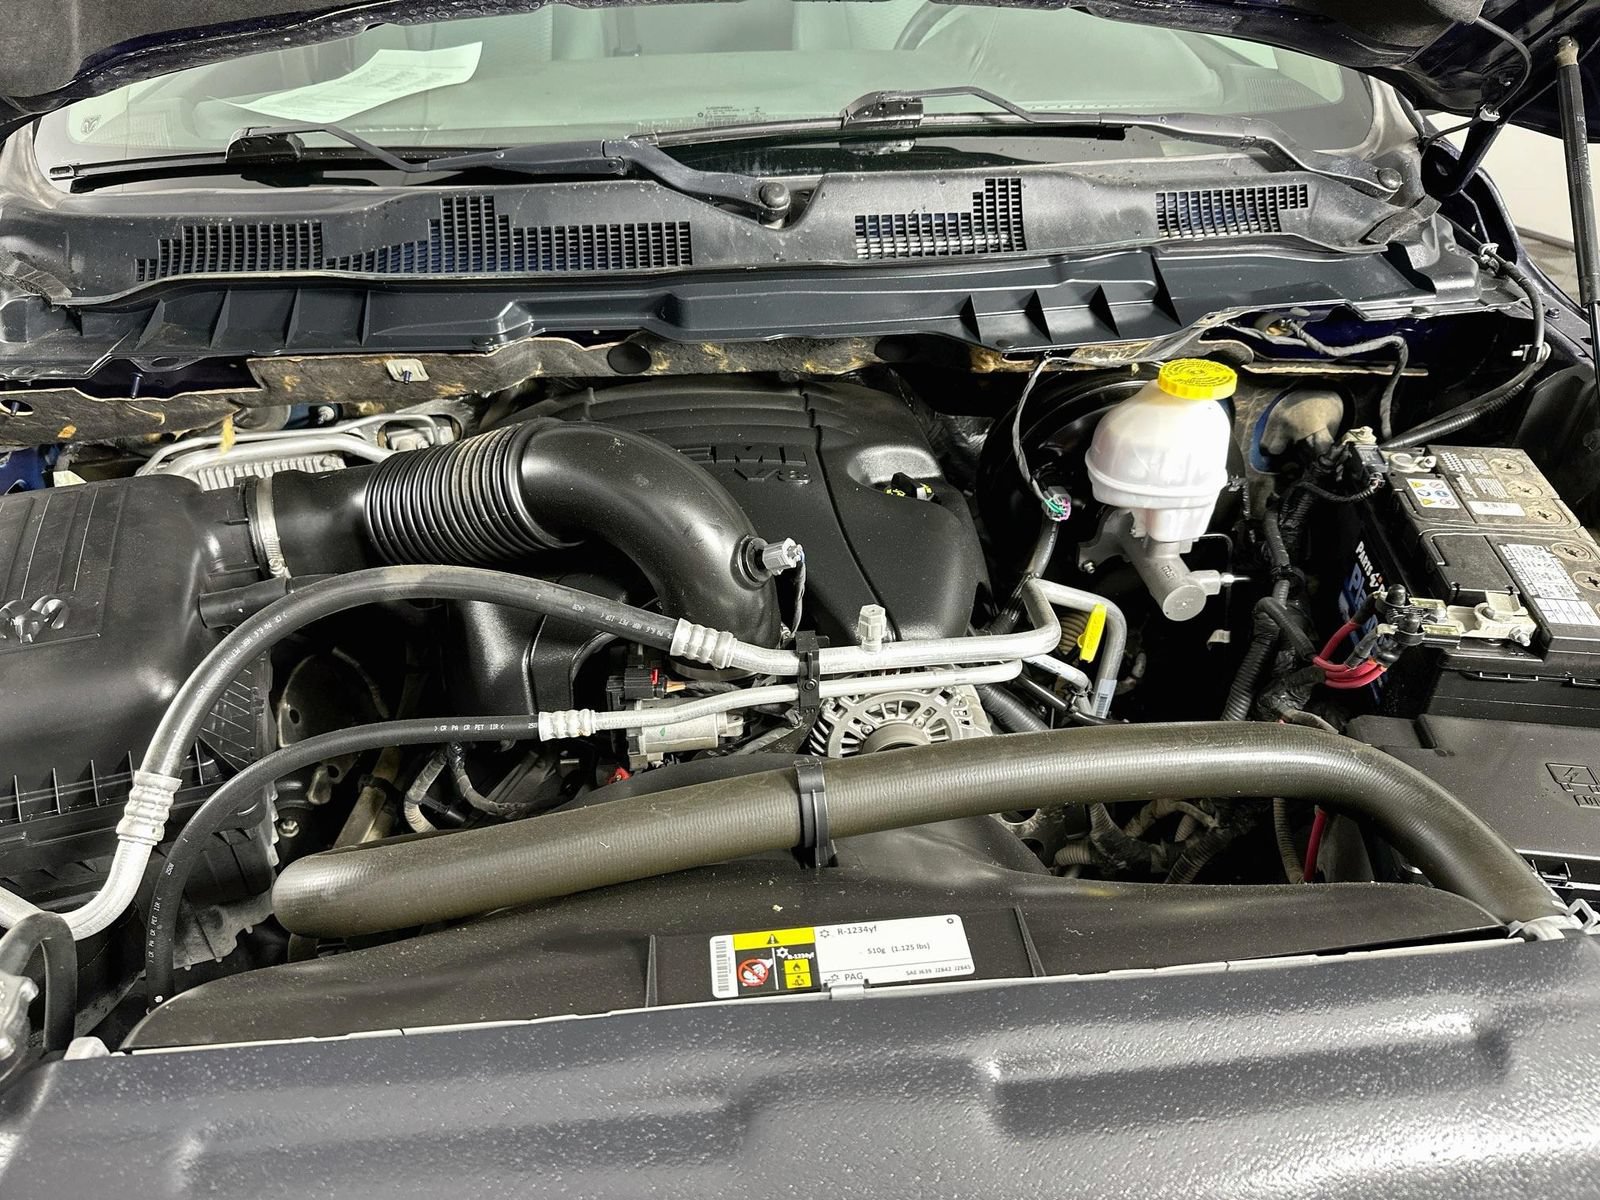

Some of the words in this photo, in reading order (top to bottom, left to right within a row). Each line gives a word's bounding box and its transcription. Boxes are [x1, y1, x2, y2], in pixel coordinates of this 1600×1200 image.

[1355, 540, 1374, 577] PARTS
[474, 723, 485, 731] PET
[836, 924, 878, 936] R-1234yf
[916, 941, 931, 951] lbs)
[844, 972, 864, 982] PAG
